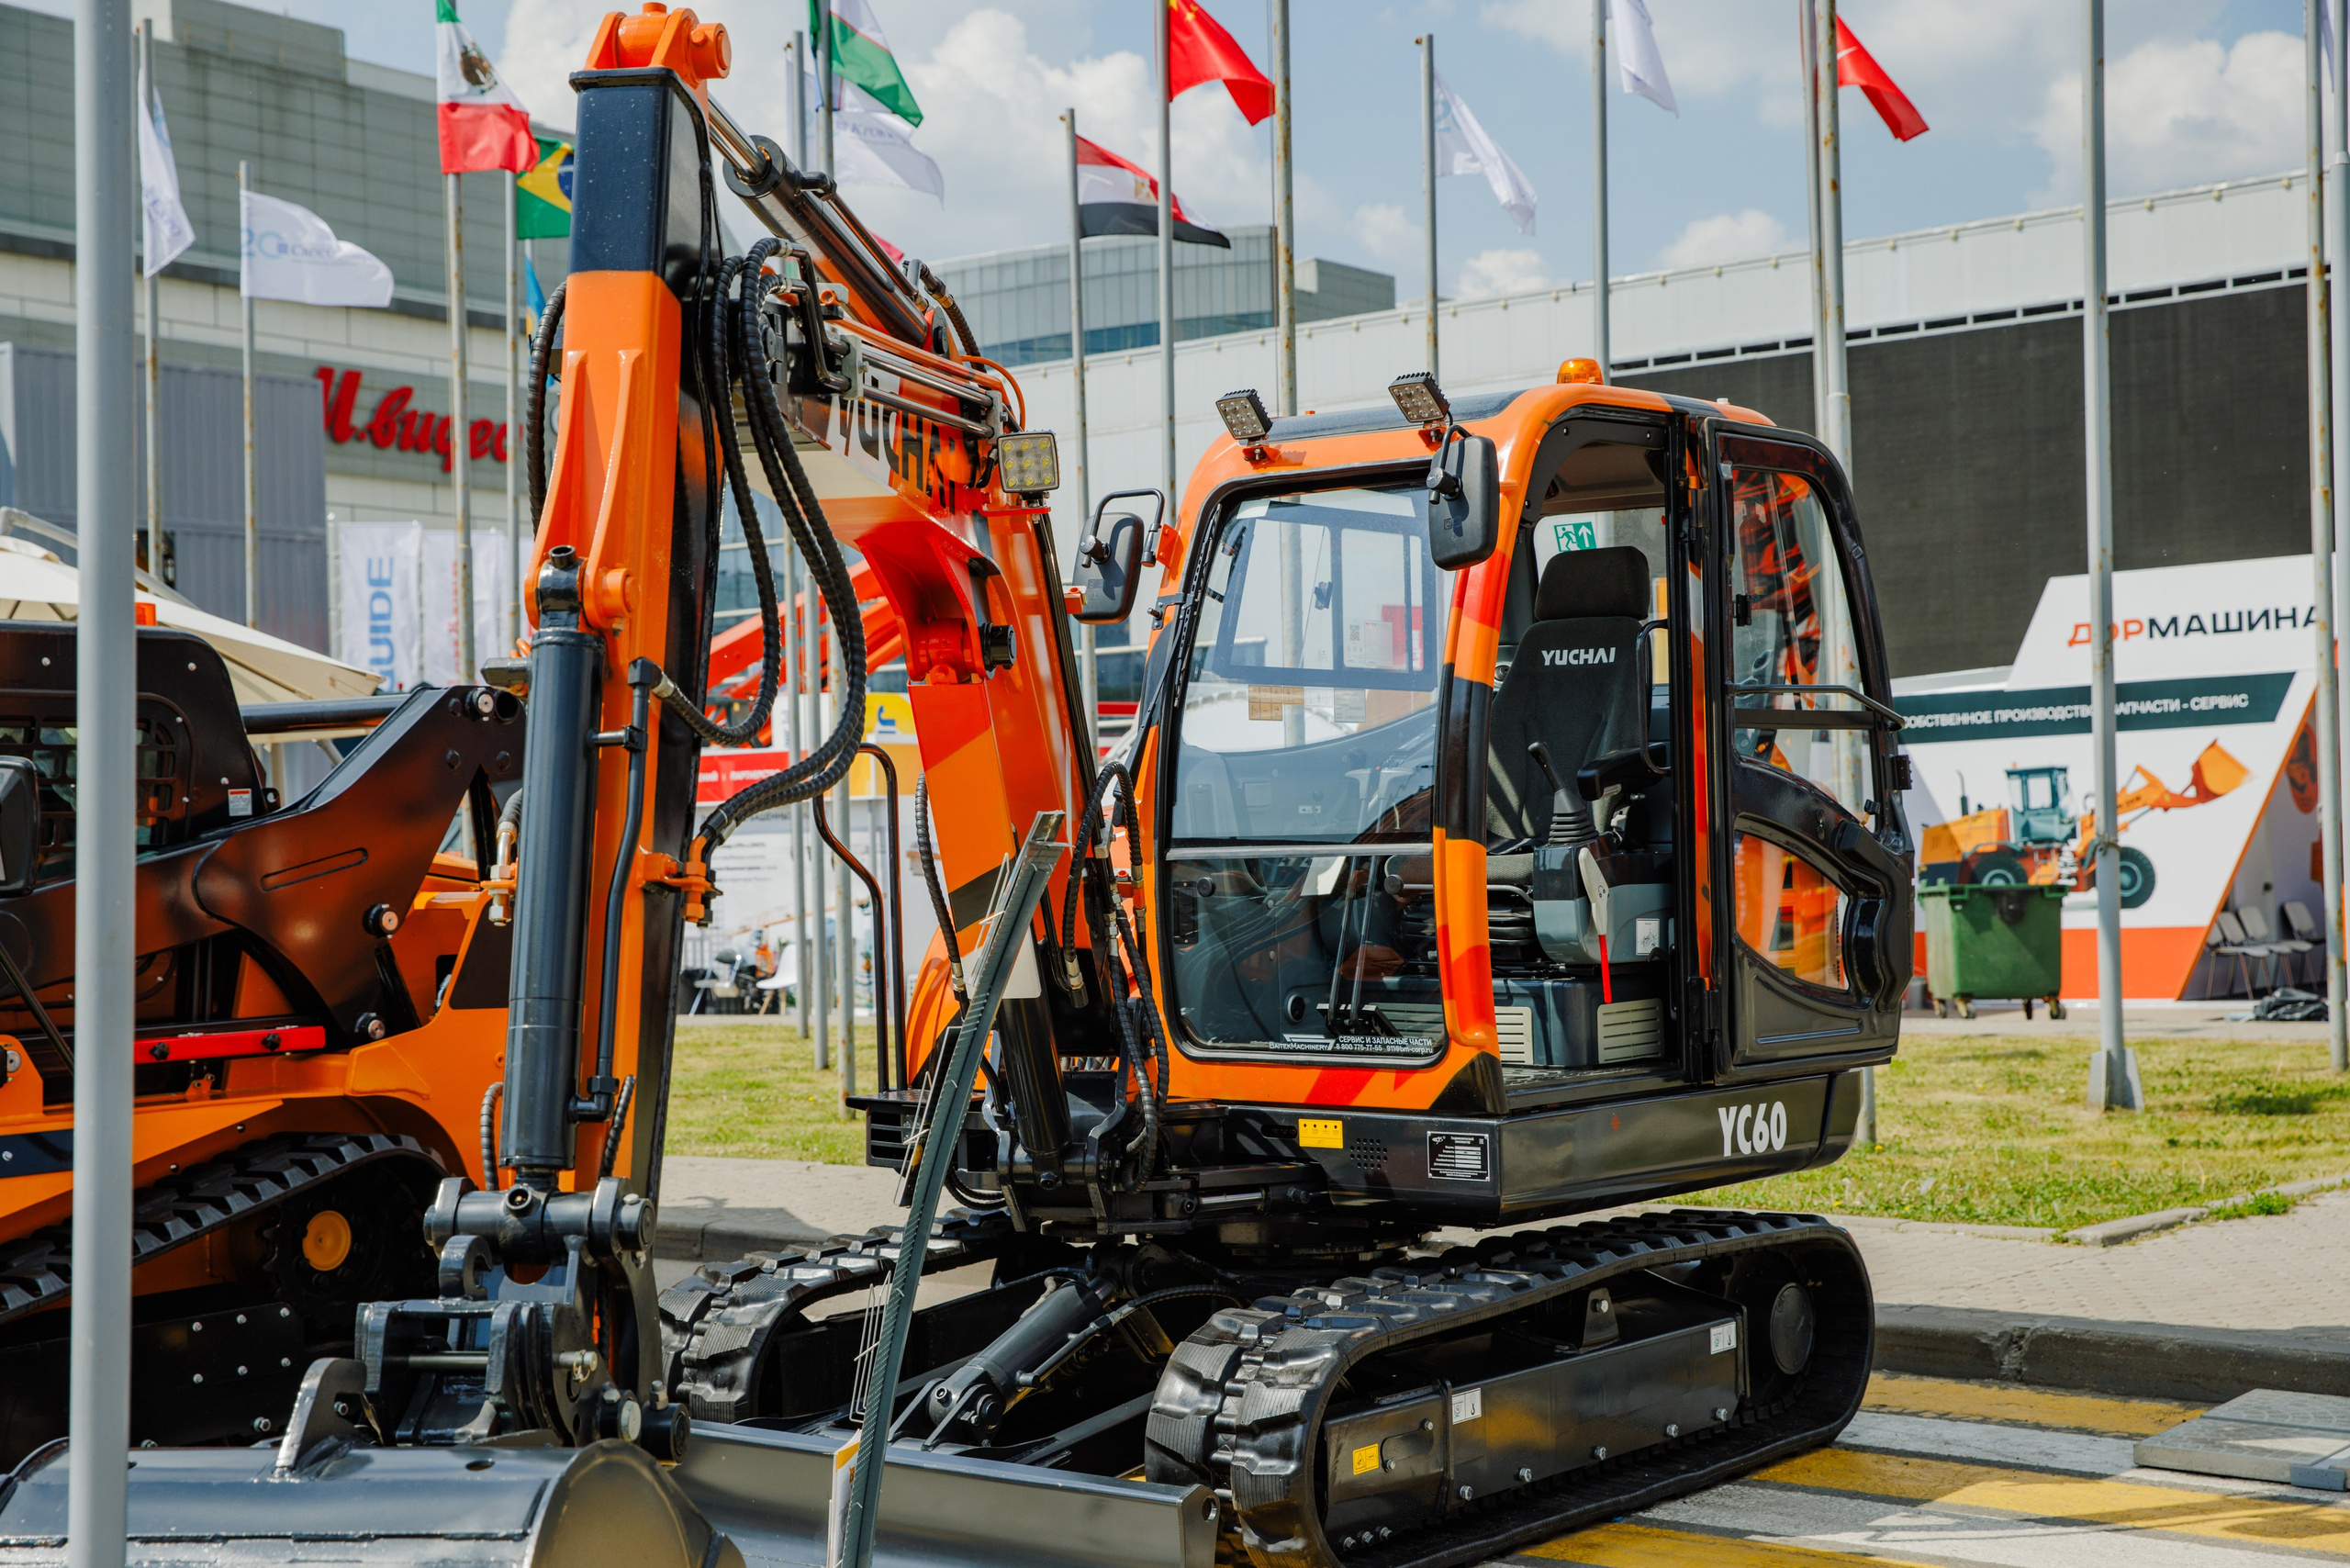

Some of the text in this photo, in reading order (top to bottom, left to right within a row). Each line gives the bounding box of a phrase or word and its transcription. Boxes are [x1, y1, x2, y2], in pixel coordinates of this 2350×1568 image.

[2067, 605, 2317, 647] ДРМАШИНА
[1541, 646, 1617, 666] YUCHAI
[2193, 693, 2249, 711] СЕРВИС
[1338, 1036, 1365, 1044] СЕРВИС
[1371, 1036, 1408, 1046] ЗАПАСНЫЕ
[1409, 1038, 1432, 1047] ЧАСТИ
[1353, 1044, 1382, 1052] 775-77-55
[1718, 1101, 1787, 1157] YC60
